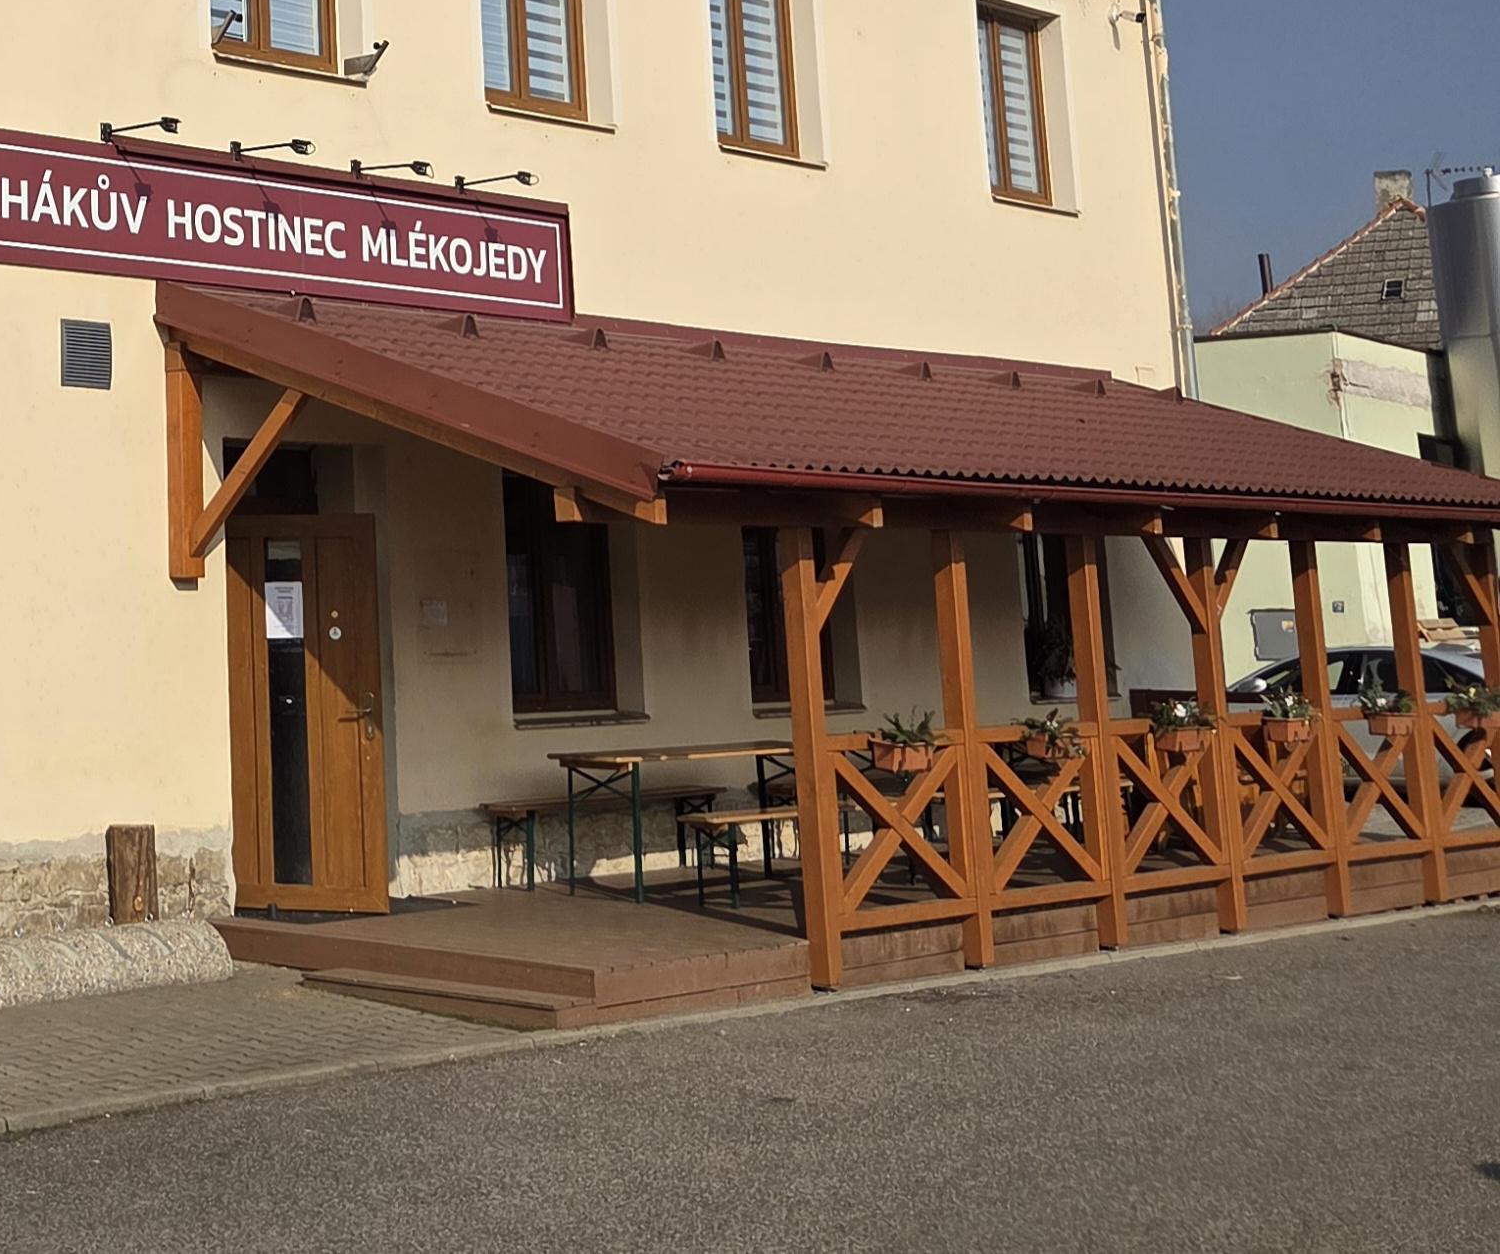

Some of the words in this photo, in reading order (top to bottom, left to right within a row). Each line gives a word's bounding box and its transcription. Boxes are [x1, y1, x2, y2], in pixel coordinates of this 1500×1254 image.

[1, 169, 148, 235] HÁKŮV
[167, 198, 347, 259] HOSTINEC
[361, 221, 547, 284] MLÉKOJEDY
